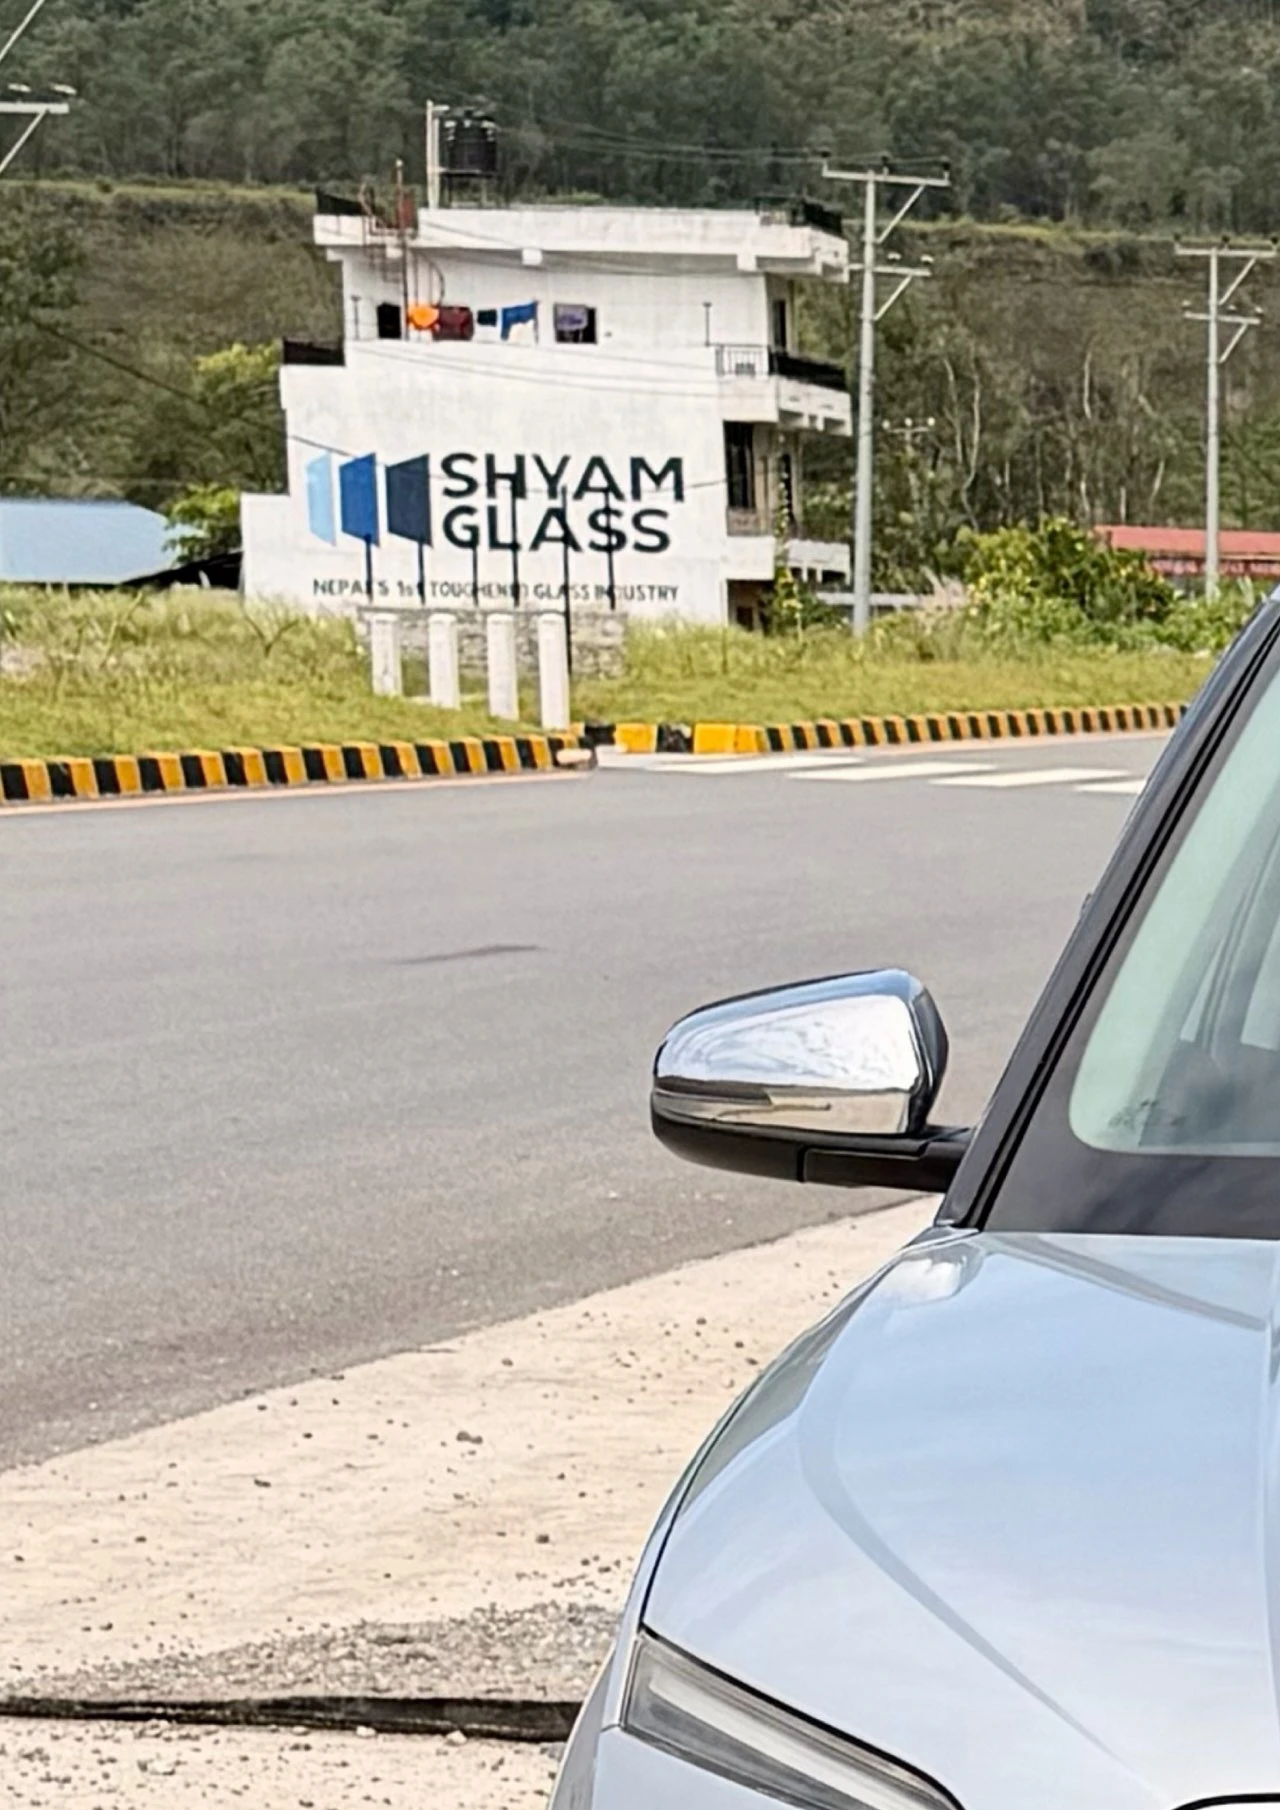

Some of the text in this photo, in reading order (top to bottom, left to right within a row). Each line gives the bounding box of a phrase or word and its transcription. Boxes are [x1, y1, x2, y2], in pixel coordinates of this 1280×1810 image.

[440, 452, 685, 502] SHYAM
[442, 504, 671, 554] GLASS
[397, 579, 424, 598] 1s
[430, 580, 529, 598] TOUGHEND
